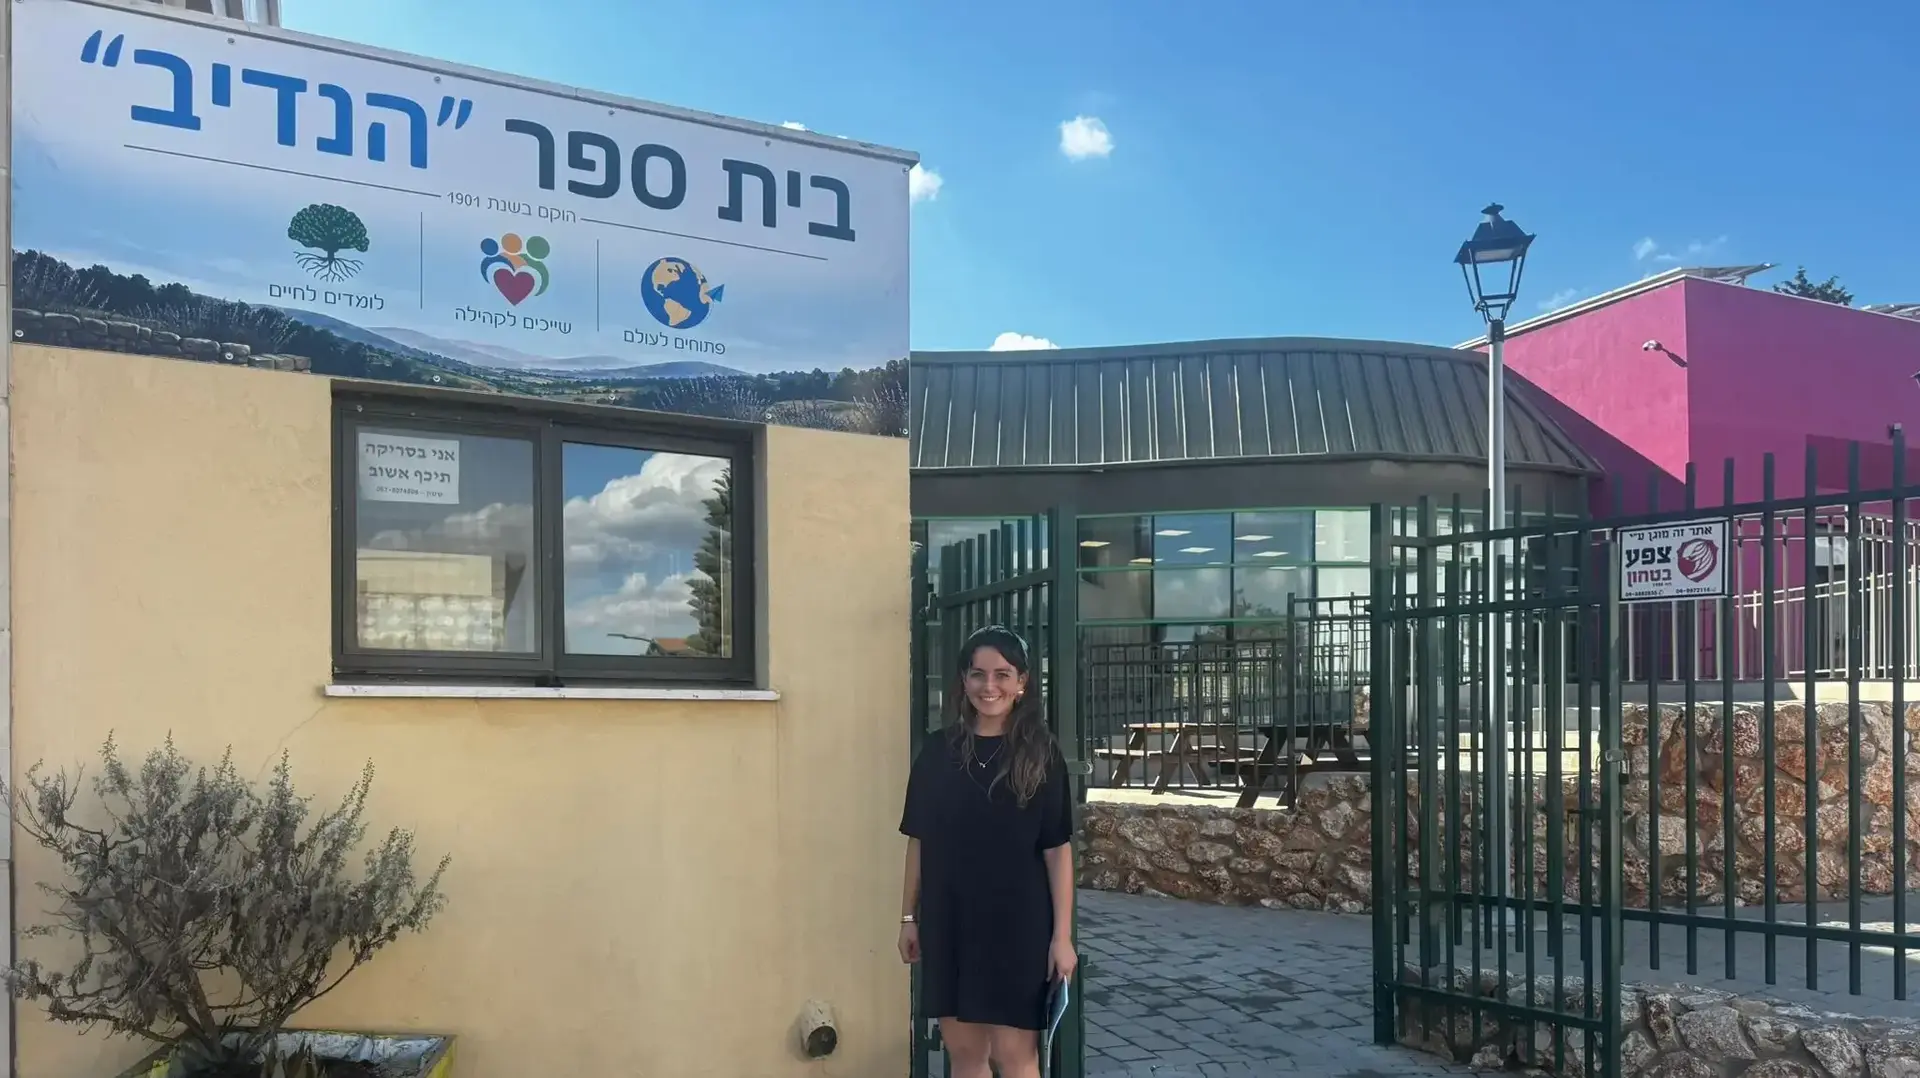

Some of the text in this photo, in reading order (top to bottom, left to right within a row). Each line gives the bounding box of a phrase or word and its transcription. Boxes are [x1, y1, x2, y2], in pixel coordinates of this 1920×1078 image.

[505, 118, 687, 210] ספר
[447, 191, 577, 223] הוקם בשנת 1901
[718, 158, 856, 242] בית
[269, 284, 385, 311] לומדים לחיים
[455, 300, 572, 335] שייכים לקהילה
[624, 328, 726, 355] פתוחים לעולם
[365, 443, 456, 461] אני בסריקה
[368, 465, 451, 485] תיכף אשוב
[1648, 531, 1670, 541] מוגן
[1672, 528, 1685, 538] זה
[1688, 526, 1713, 536] אתר
[1625, 546, 1672, 569] צפע
[1627, 568, 1672, 588] בטחון
